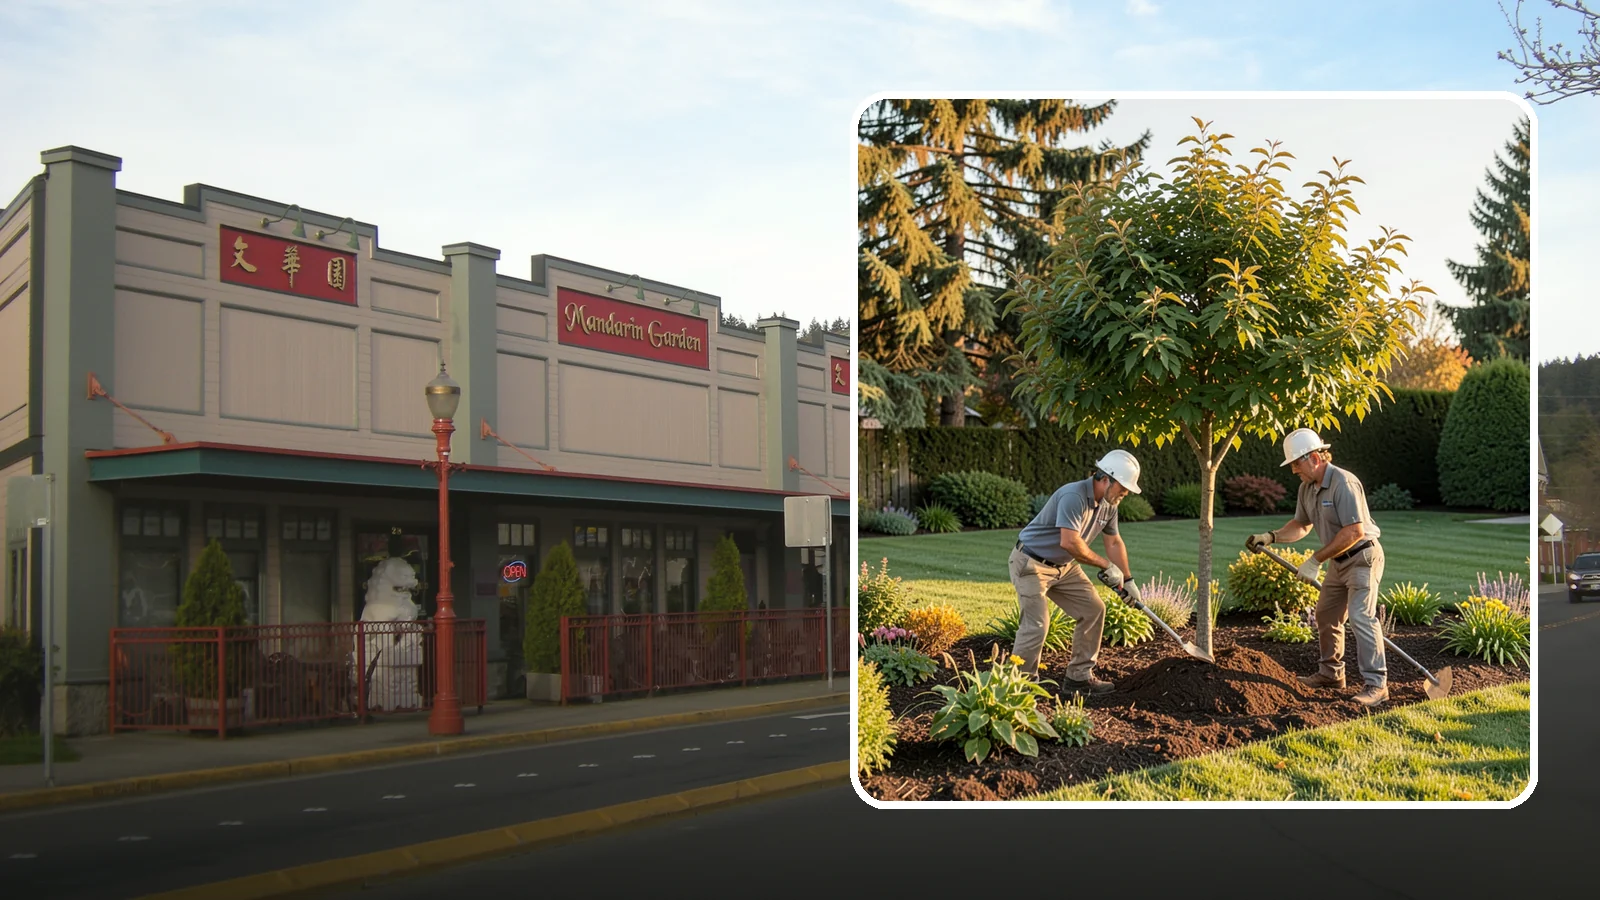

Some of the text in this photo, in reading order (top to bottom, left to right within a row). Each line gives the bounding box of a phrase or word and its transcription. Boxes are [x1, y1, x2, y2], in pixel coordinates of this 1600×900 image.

[230, 235, 346, 290] 文華園
[564, 302, 701, 352] Mandarin Garden
[835, 363, 846, 386] 文
[503, 565, 527, 578] OPEN
